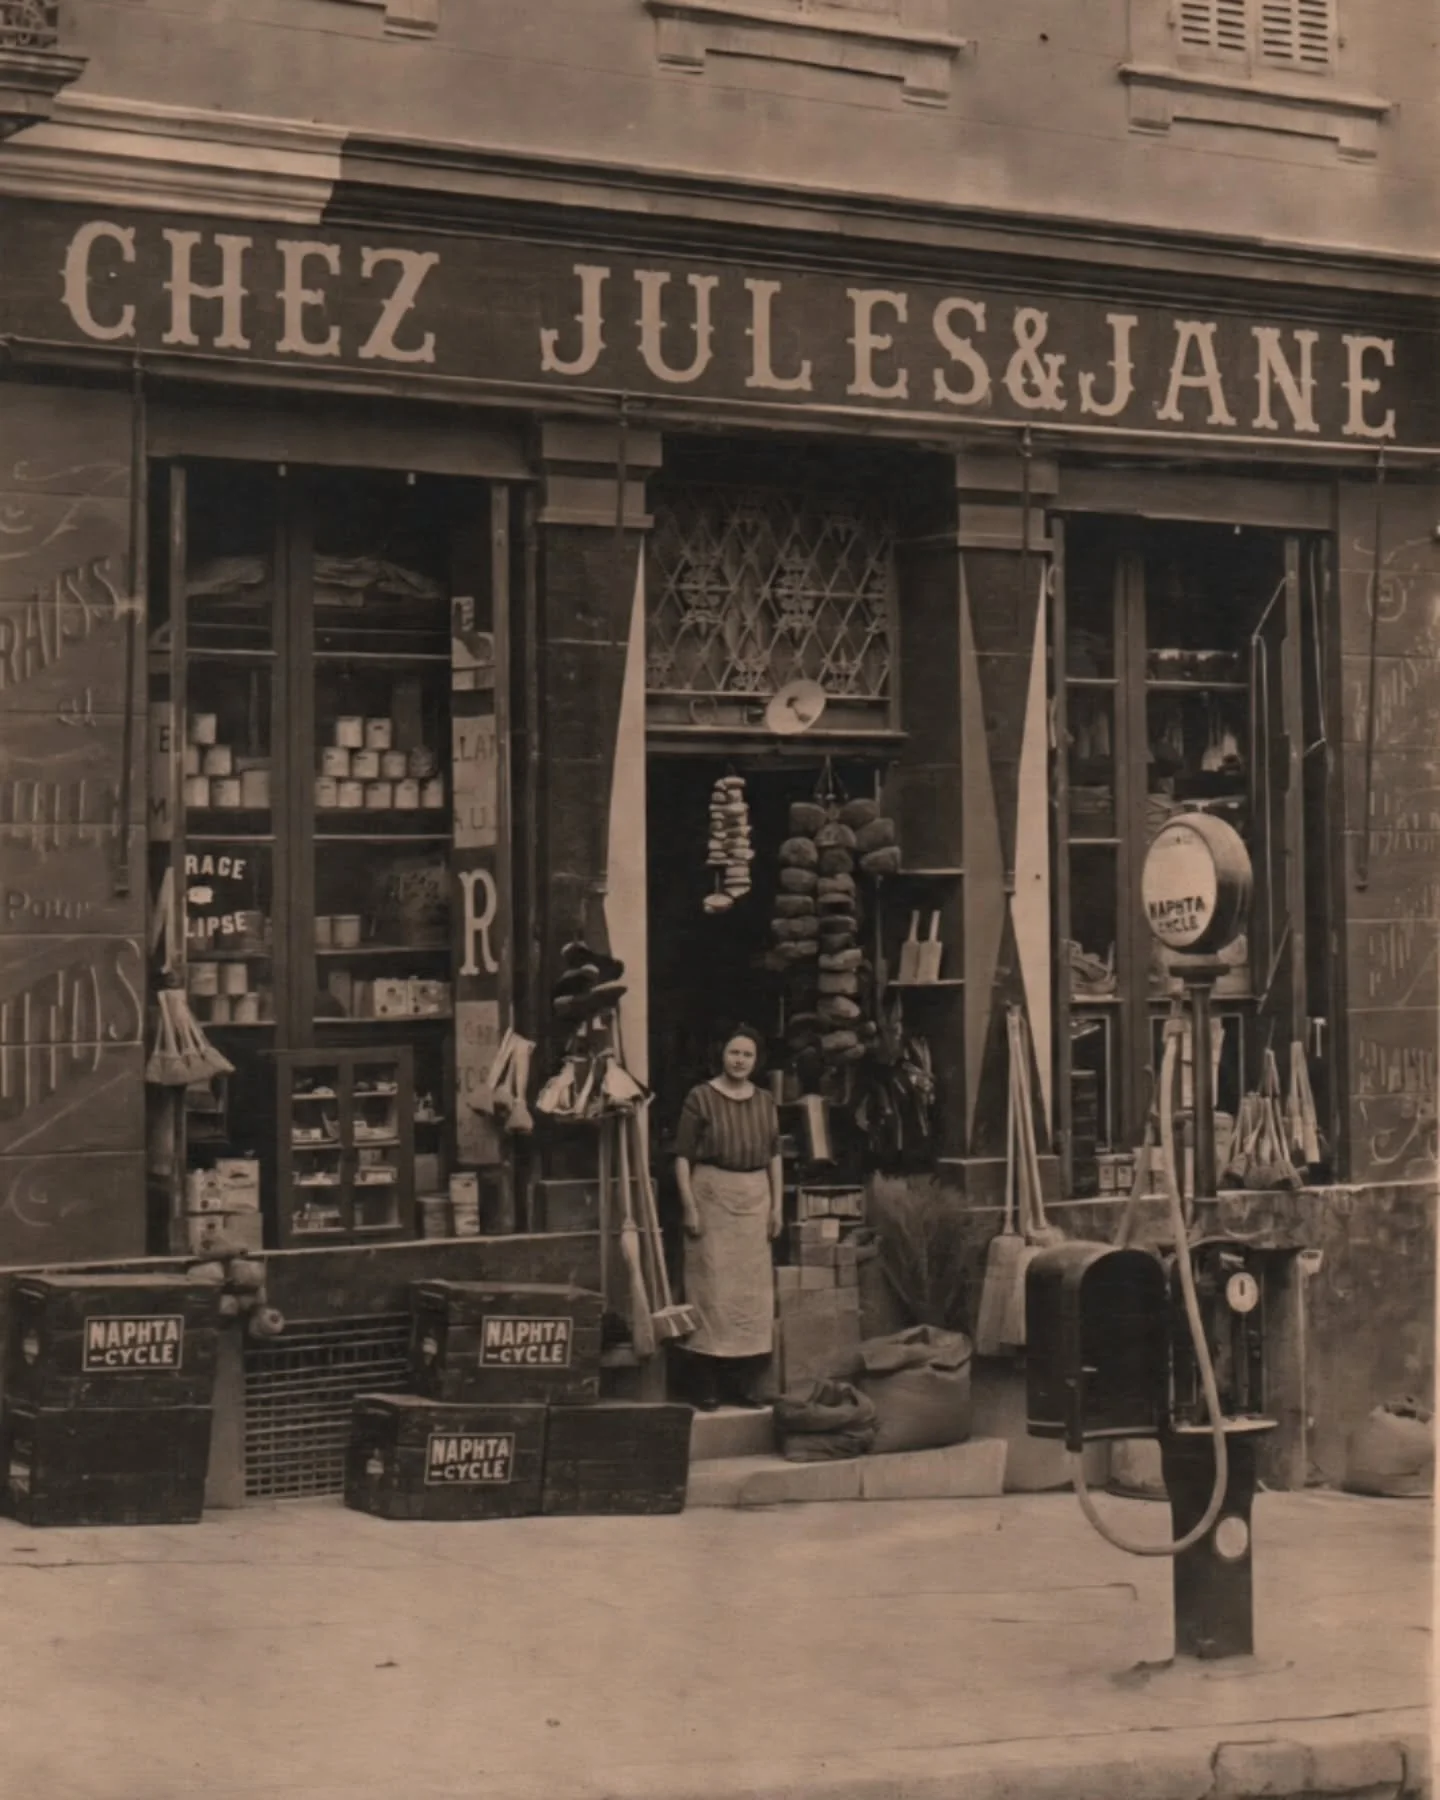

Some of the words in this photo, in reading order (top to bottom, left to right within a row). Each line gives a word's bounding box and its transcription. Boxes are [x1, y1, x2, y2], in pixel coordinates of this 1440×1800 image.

[60, 221, 439, 363] CHEZ
[1149, 896, 1206, 920] NAPHTA
[89, 1319, 178, 1349] NAPHTA
[486, 1320, 567, 1347] NAPHTA
[431, 1438, 509, 1465] NAPHTA
